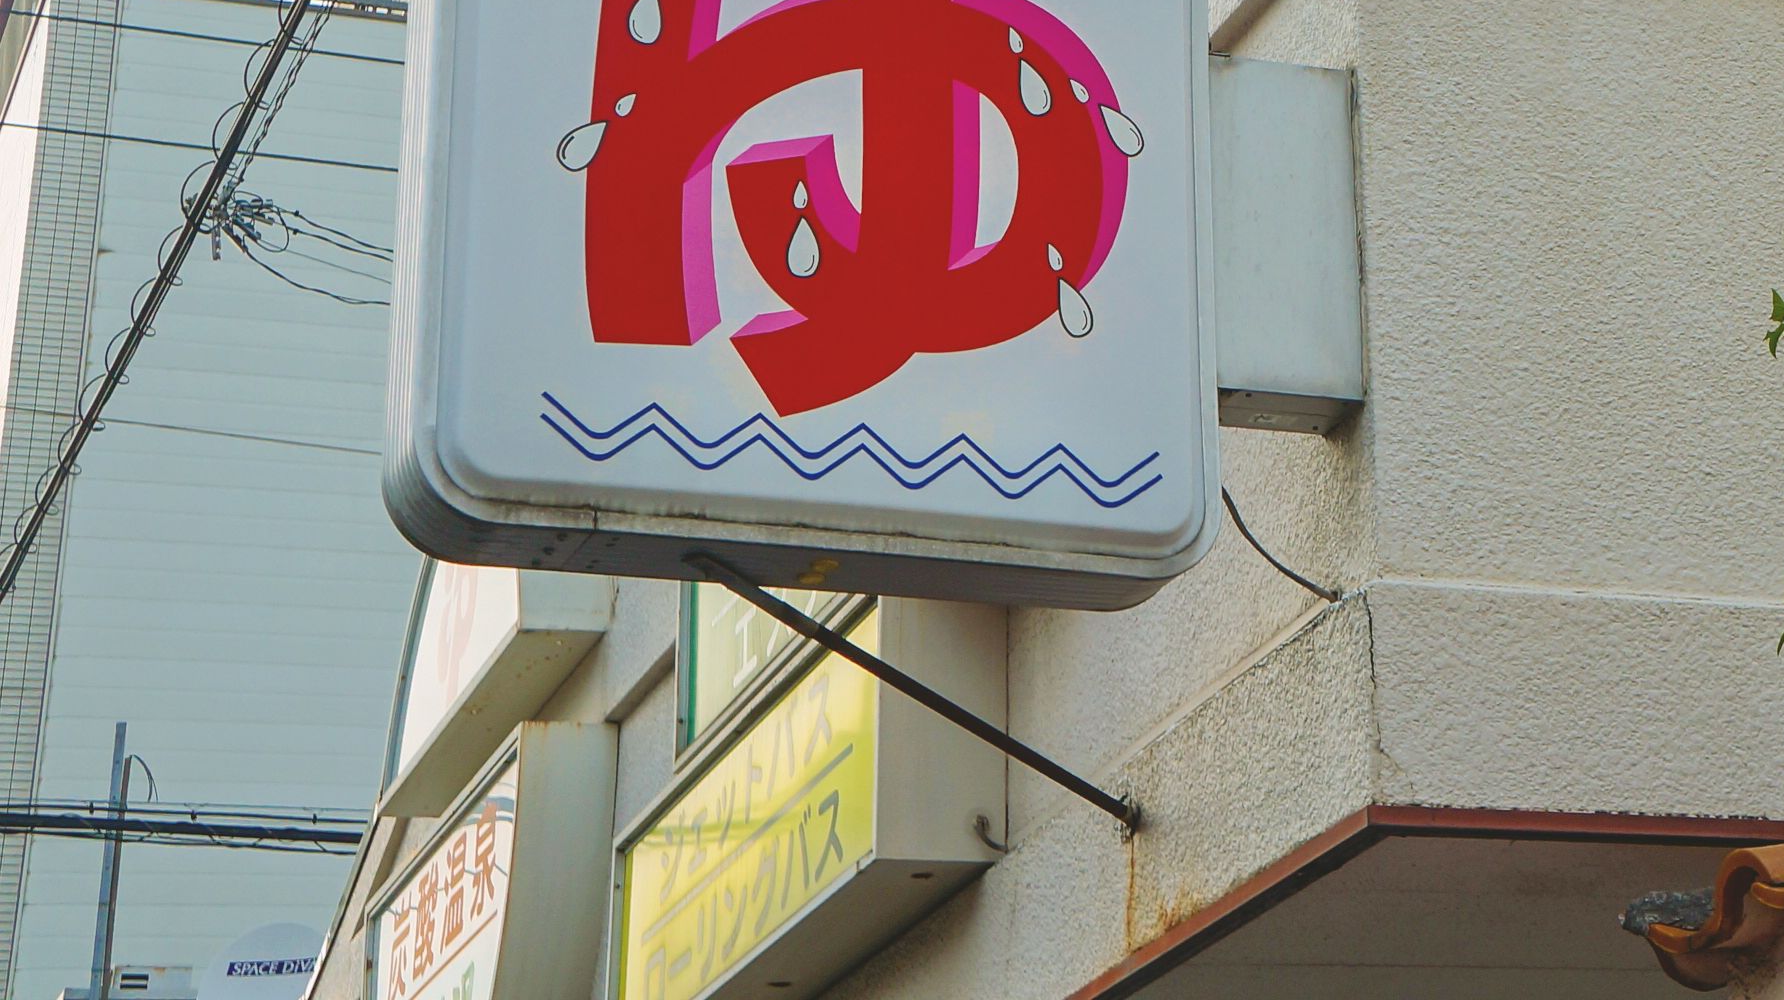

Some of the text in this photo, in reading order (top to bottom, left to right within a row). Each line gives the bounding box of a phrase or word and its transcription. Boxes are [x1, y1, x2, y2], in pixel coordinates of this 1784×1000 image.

[659, 673, 833, 904] ジェットバス
[232, 961, 279, 976] SPACE
[387, 801, 497, 1000] 炭酸温泉
[644, 789, 844, 1000] ローリングバス
